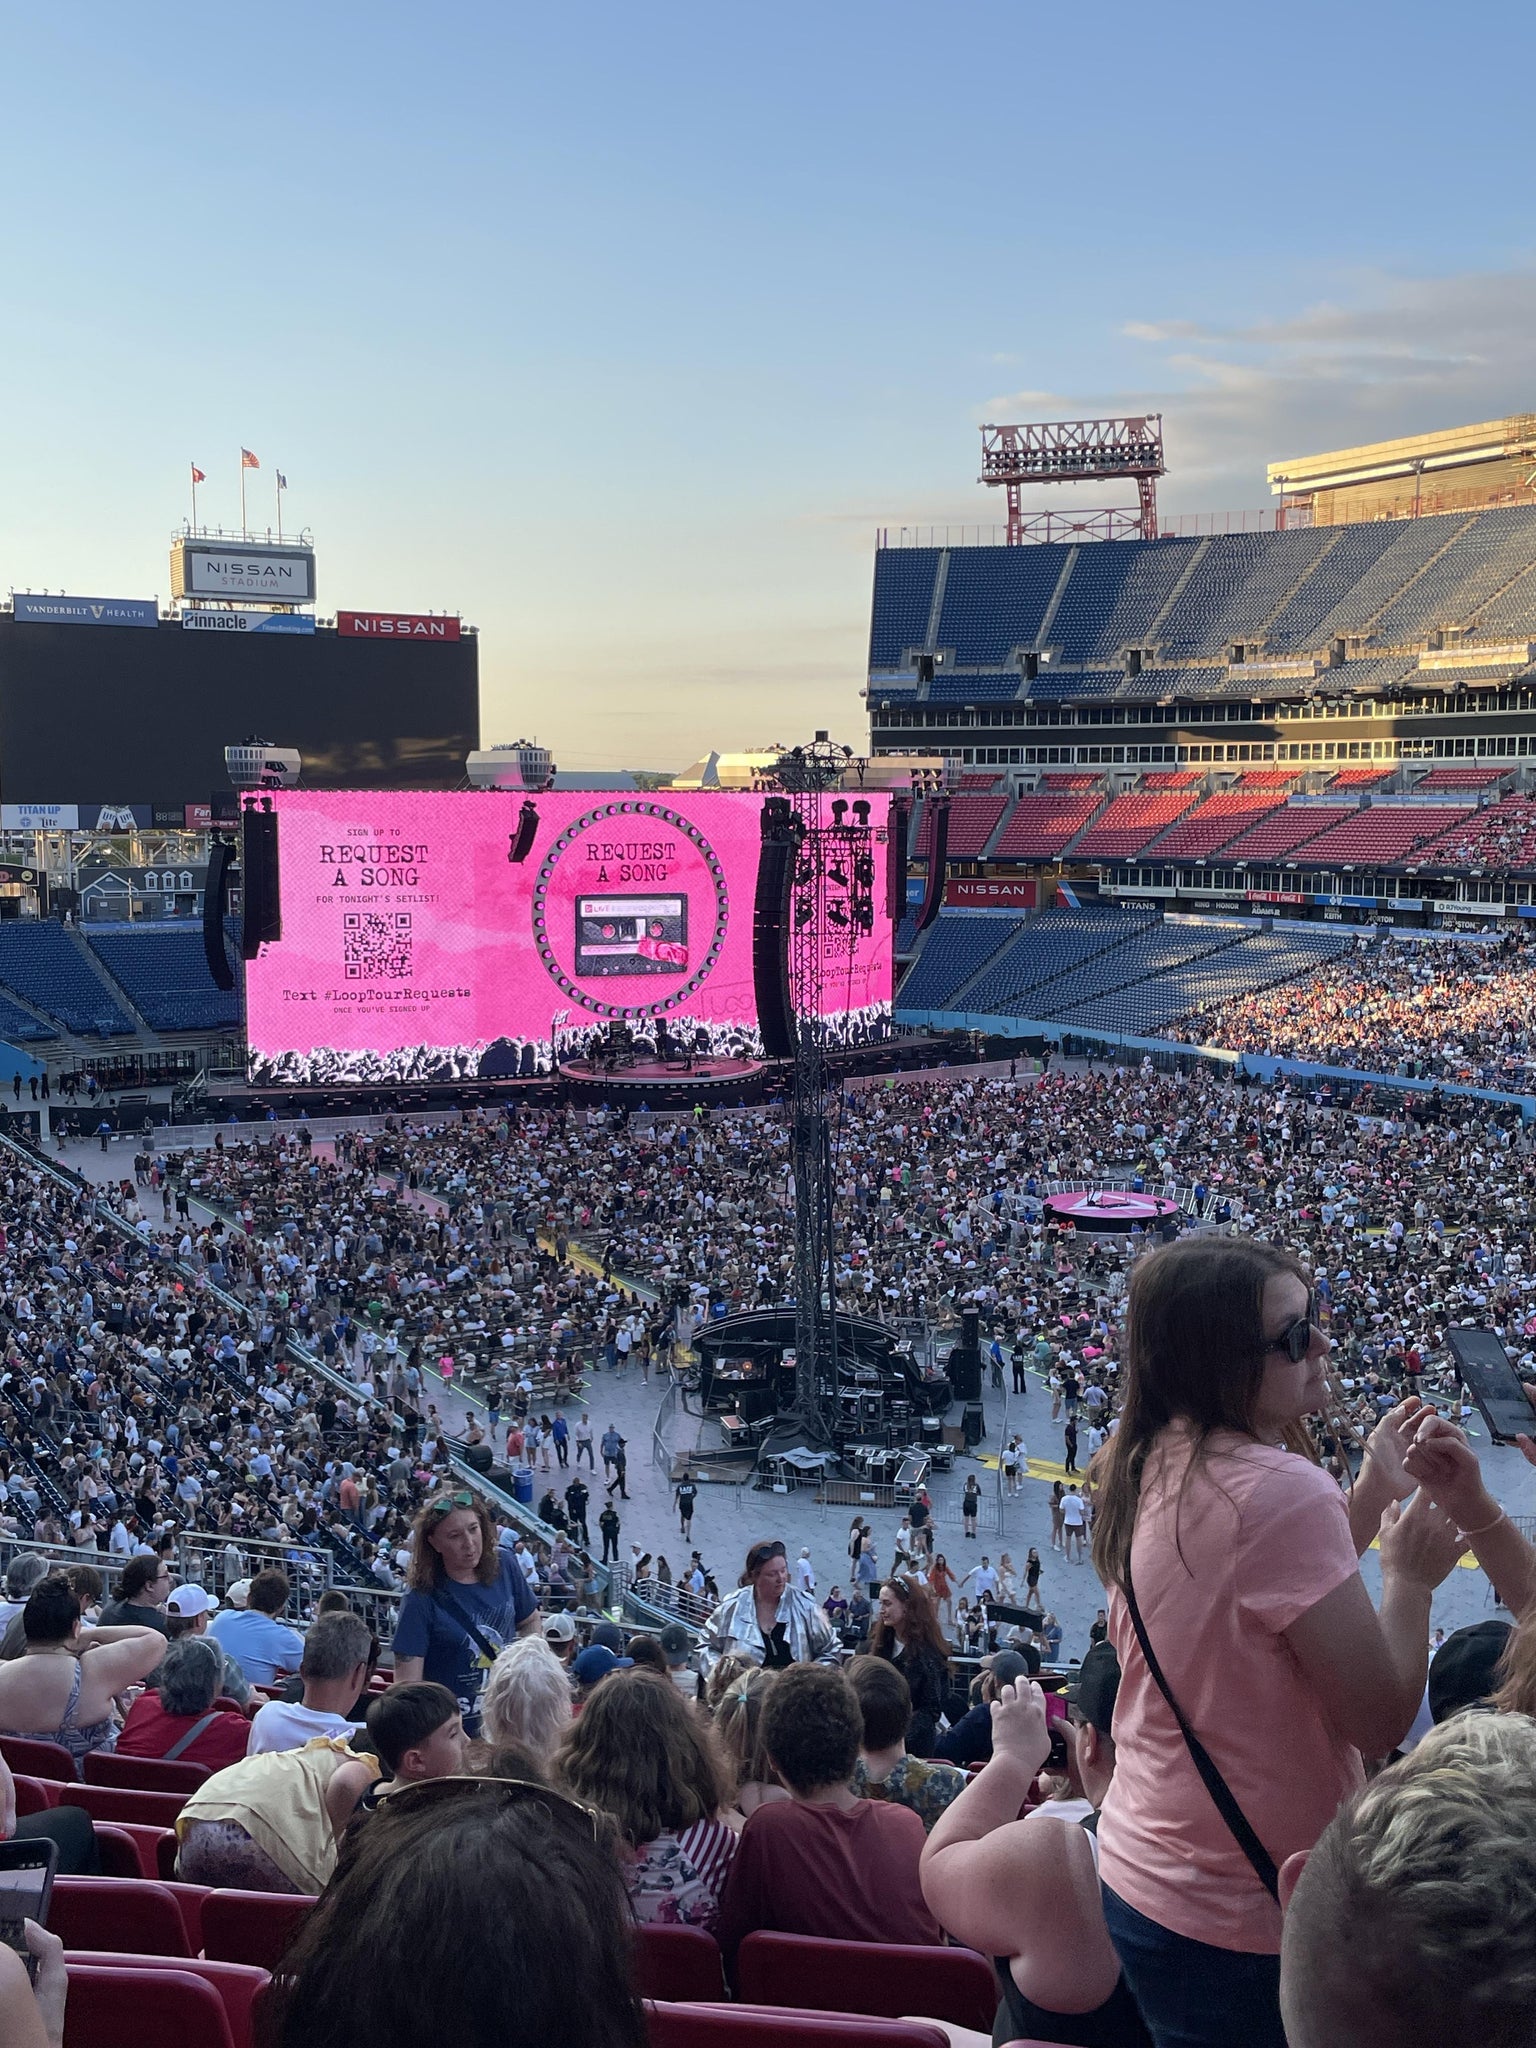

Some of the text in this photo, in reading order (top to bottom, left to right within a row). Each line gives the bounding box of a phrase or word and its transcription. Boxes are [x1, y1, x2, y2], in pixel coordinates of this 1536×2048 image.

[207, 561, 292, 577] NISSAN
[222, 577, 279, 588] STADIUM
[26, 605, 87, 615] VANDERBILT
[106, 610, 145, 618] HEALTH
[185, 612, 247, 630] Pinnacle
[354, 619, 445, 635] NISSAN
[18, 806, 61, 815] TITAN UP
[319, 845, 429, 864] REQUEST
[586, 842, 676, 862] REQUEST
[331, 868, 421, 887] A SONG
[597, 864, 669, 883] A SONG
[957, 884, 1025, 896] NISSAN
[316, 894, 440, 904] FOR TONIGHT'S SETLIST!
[1120, 901, 1156, 911] TITANS
[1215, 902, 1240, 910] HONOR
[1323, 912, 1342, 921] KEITH
[282, 987, 471, 1003] Text #LoopTourRequests
[333, 1004, 431, 1014] ONCE YOU'VE SIGNED UP
